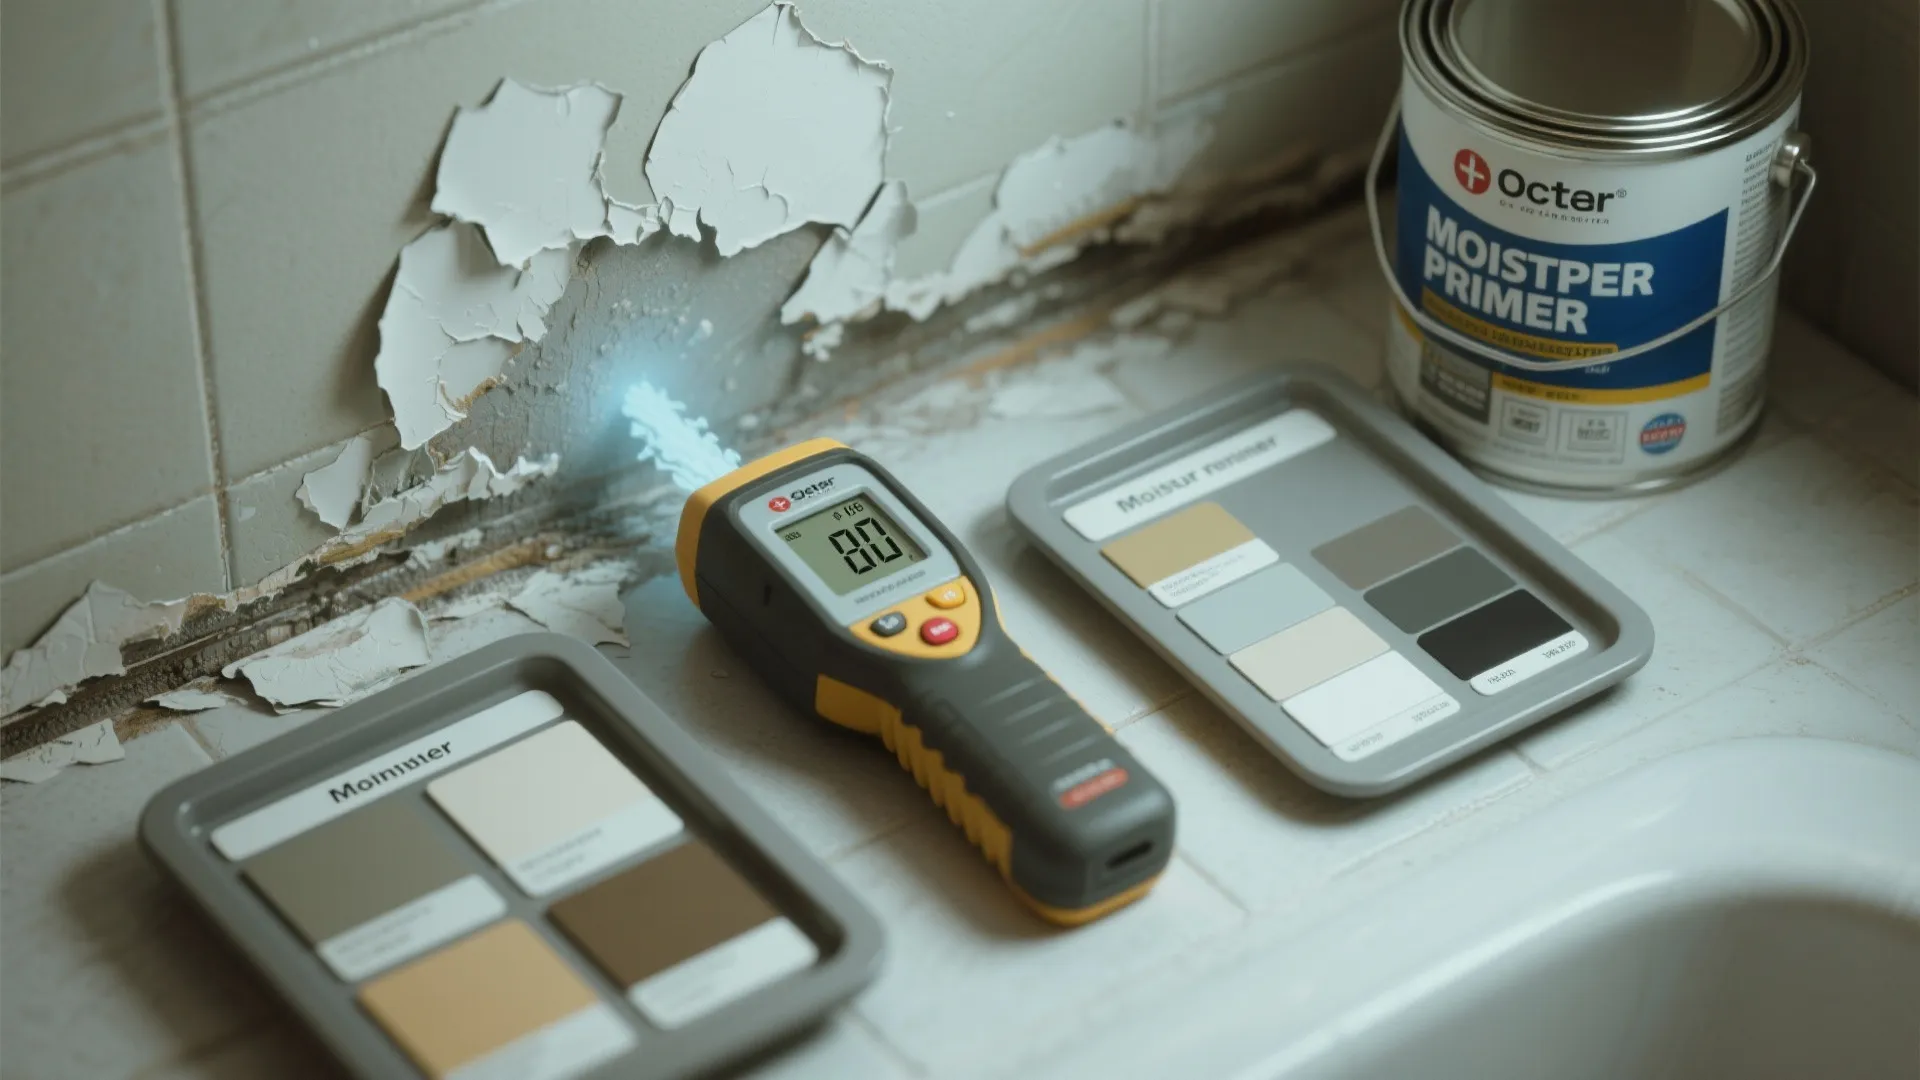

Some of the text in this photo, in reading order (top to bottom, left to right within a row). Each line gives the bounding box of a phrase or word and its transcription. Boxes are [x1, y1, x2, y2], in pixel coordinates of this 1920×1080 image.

[1424, 244, 1589, 335] PRIMER
[1425, 204, 1655, 298] MOISTPER
[828, 516, 904, 576] 80
